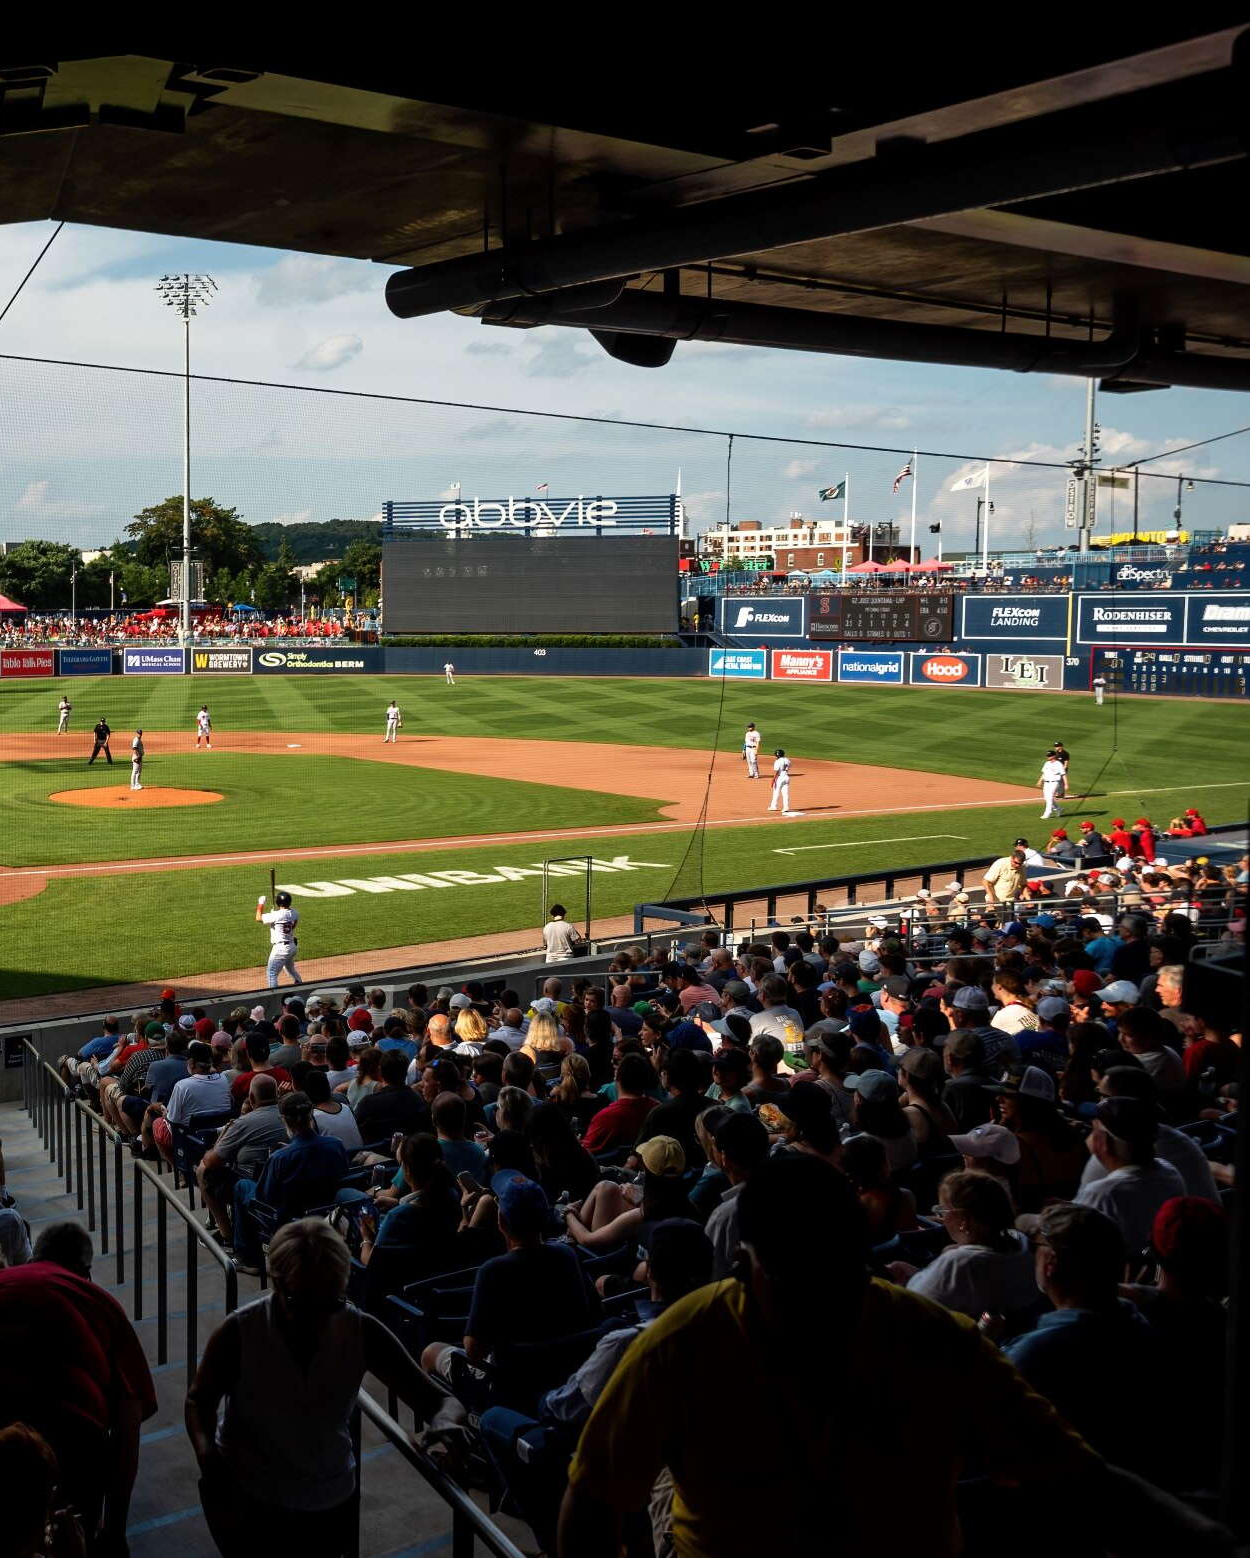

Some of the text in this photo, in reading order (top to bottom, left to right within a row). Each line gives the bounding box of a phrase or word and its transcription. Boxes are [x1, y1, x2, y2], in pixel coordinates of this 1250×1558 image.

[439, 495, 618, 529] abbvie
[1093, 608, 1172, 621] RODENHISER
[991, 618, 1039, 626] LANDING
[2, 657, 52, 668] Table Talk Pies
[195, 654, 208, 668] W
[287, 653, 307, 661] Simply
[780, 654, 823, 668] Manny's
[1066, 658, 1079, 666] 370
[843, 658, 898, 673] nationalgrid
[927, 663, 962, 676] Hood
[1002, 656, 1048, 683] LEI
[274, 856, 674, 898] UNIBANK
